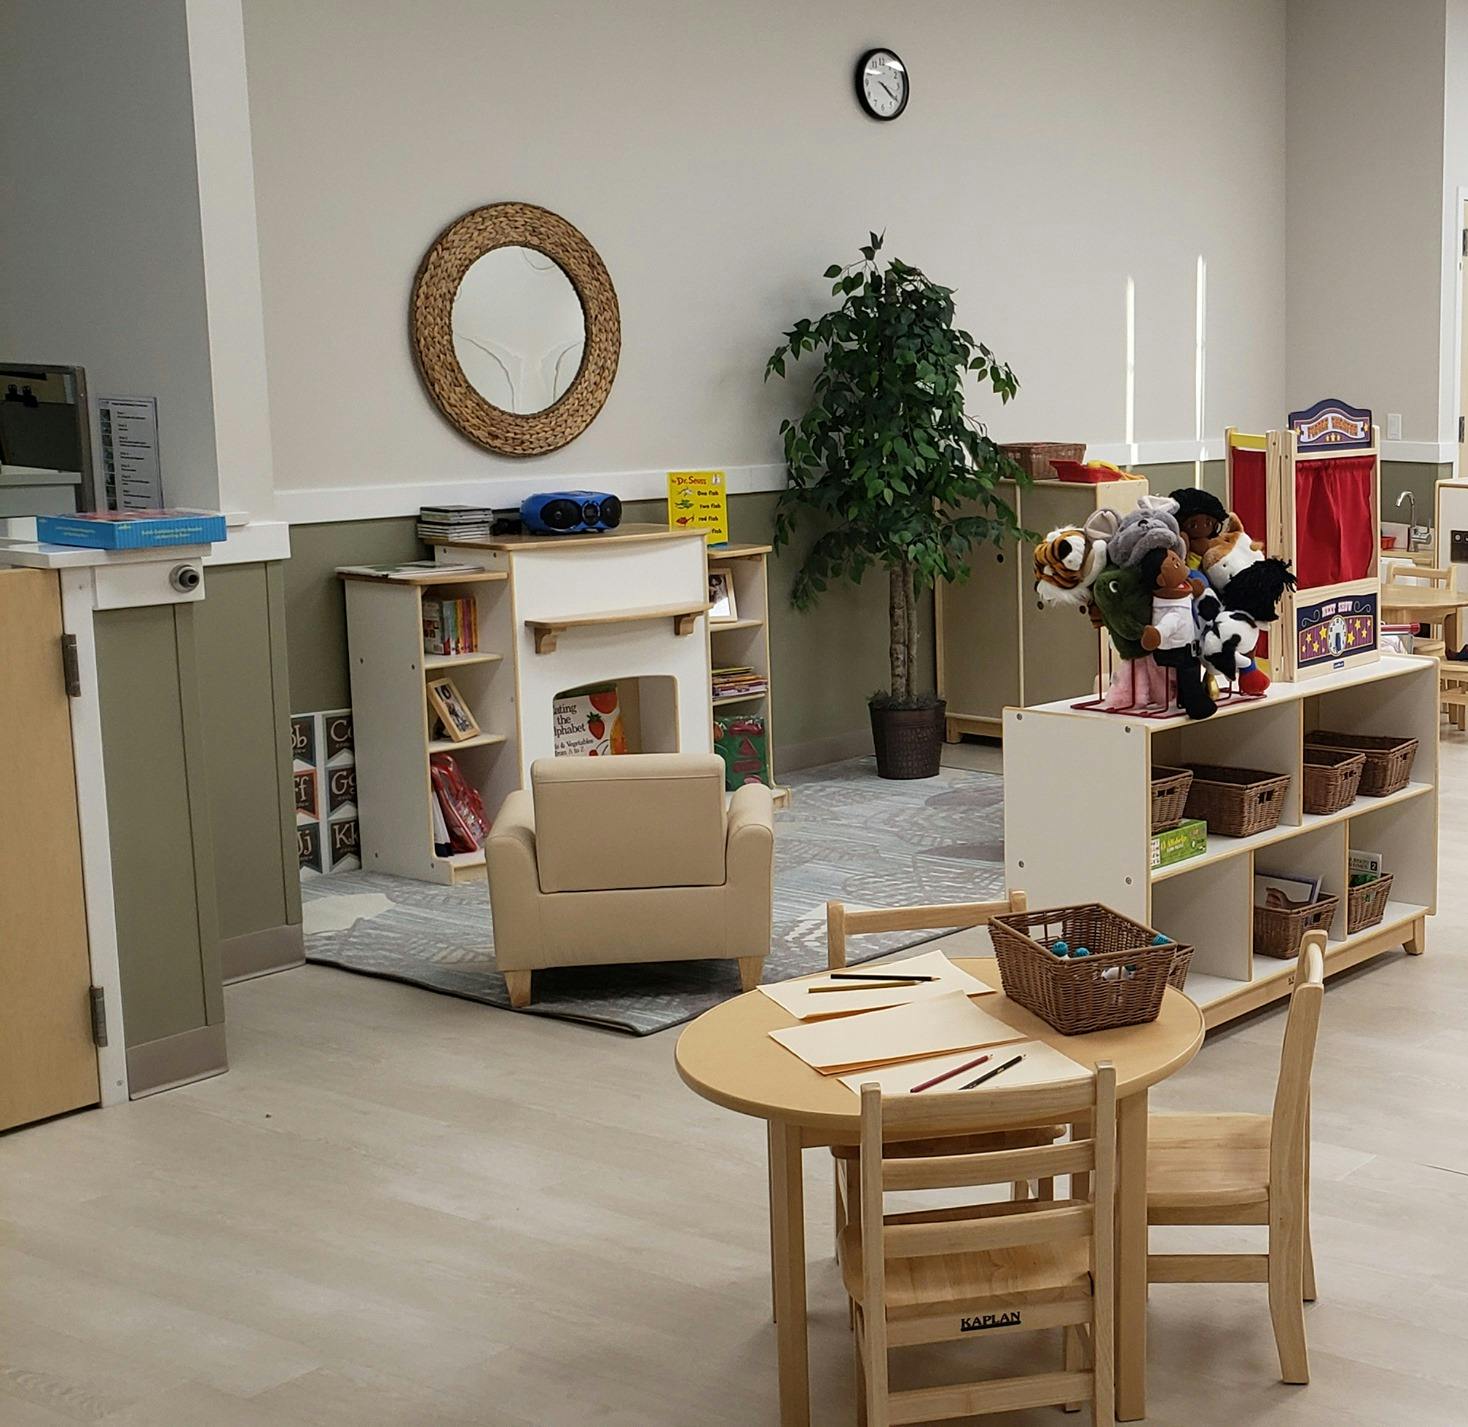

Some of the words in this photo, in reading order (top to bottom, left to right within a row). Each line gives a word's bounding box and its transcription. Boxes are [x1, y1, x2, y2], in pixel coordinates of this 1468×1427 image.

[554, 704, 577, 714] ating
[557, 715, 571, 724] the
[960, 1311, 1020, 1330] KAPLAN
